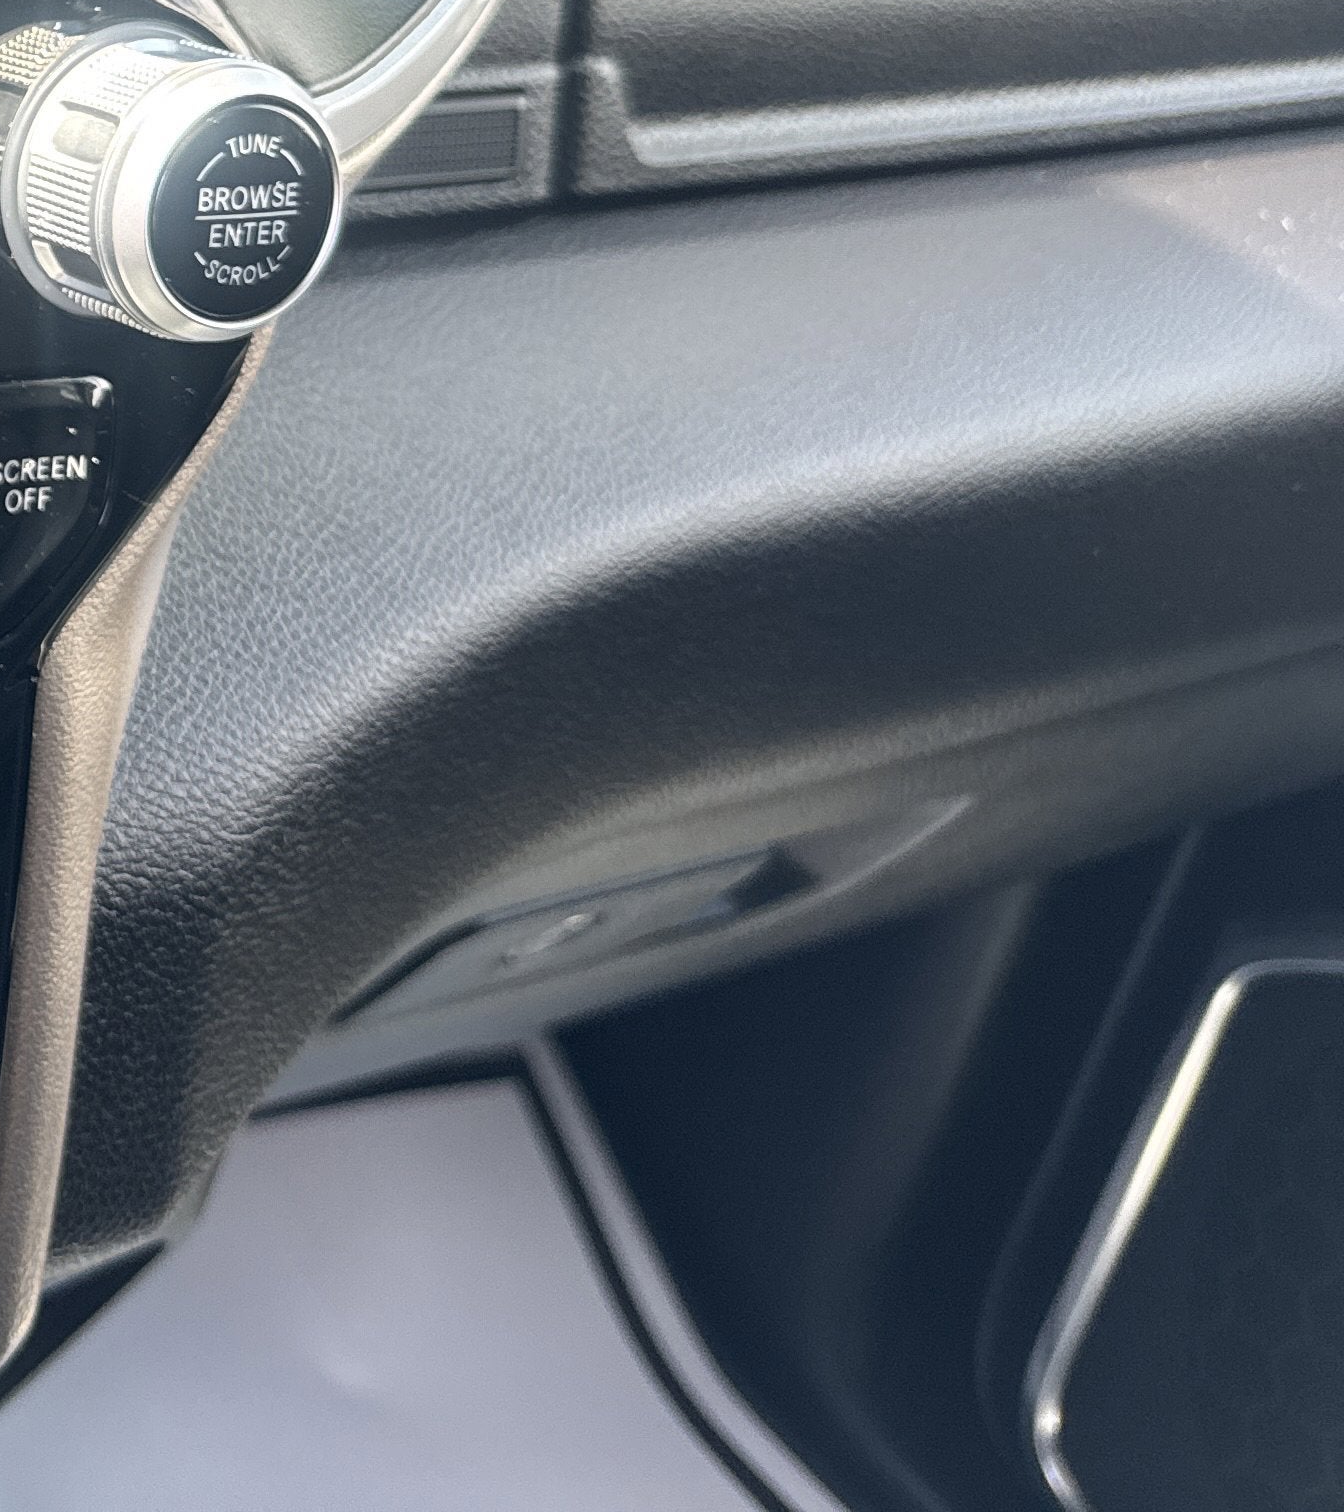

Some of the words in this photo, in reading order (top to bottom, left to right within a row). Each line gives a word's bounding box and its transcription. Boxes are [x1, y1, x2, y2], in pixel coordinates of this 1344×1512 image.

[225, 134, 284, 159] TUNE
[198, 182, 300, 212] BROWSE
[208, 220, 288, 248] ENTER
[204, 257, 281, 286] SCROLL
[4, 486, 54, 515] OFF
